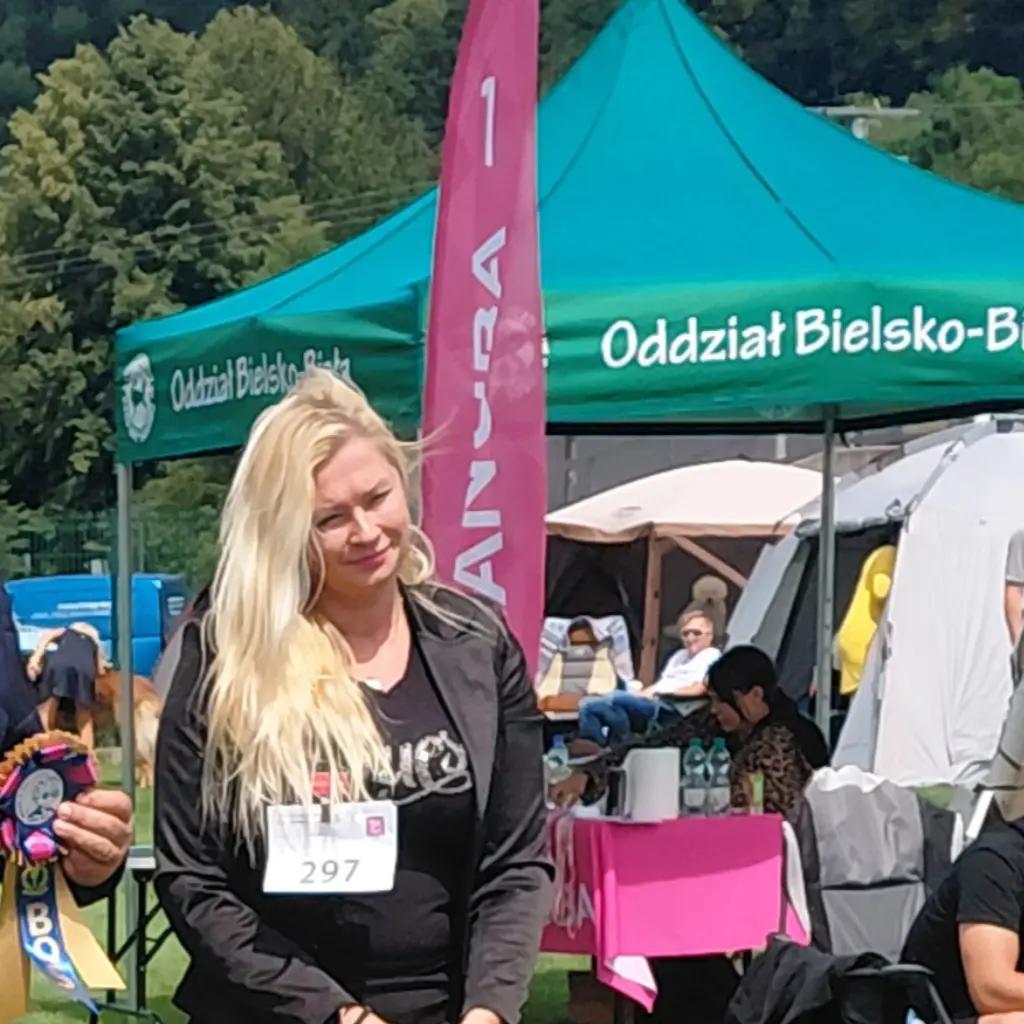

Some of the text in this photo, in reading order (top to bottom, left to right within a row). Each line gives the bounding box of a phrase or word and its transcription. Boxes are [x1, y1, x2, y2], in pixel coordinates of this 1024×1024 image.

[601, 305, 1024, 368] Oddział Bielsko-B
[171, 358, 233, 412] Oddział
[300, 859, 360, 884] 297
